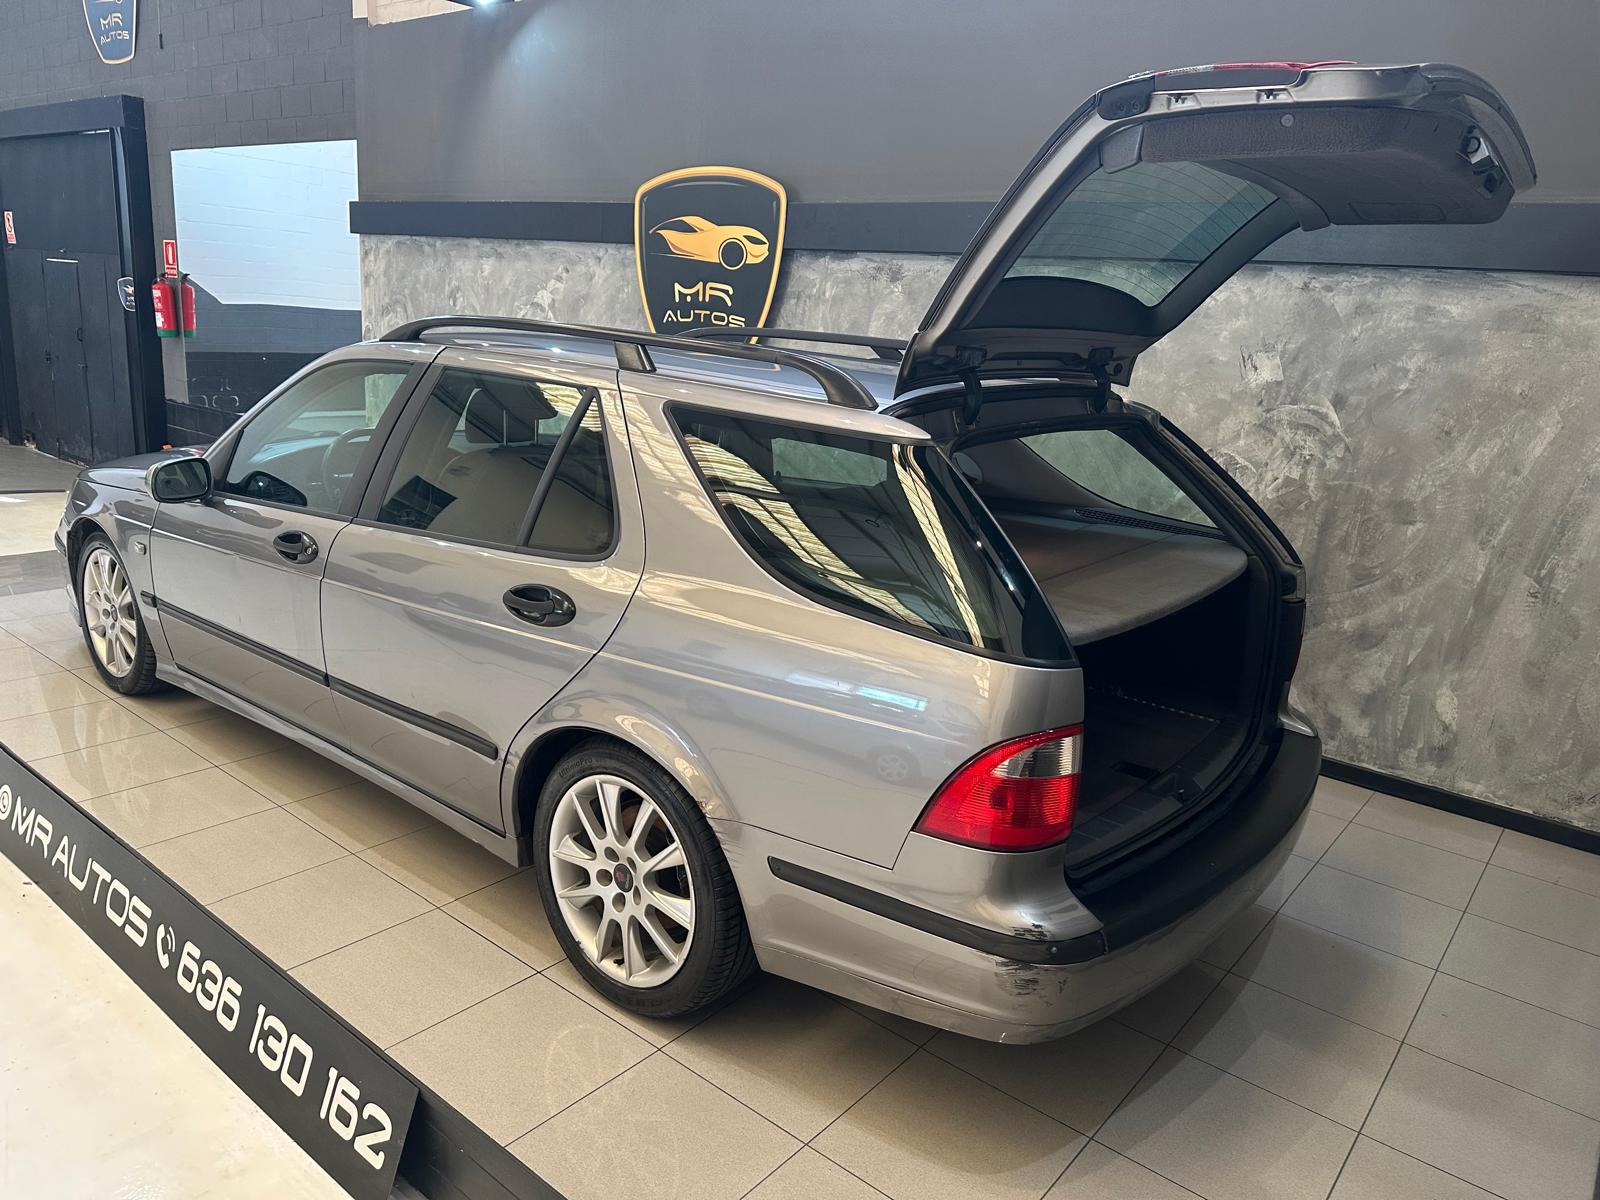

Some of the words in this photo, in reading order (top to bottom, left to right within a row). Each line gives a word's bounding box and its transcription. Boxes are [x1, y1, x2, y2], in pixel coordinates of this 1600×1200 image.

[100, 12, 123, 31] MR
[100, 30, 130, 45] AUTOS
[674, 281, 734, 307] MR
[663, 309, 746, 328] AUTOS
[11, 795, 53, 859] MR
[51, 835, 153, 947] AUTOS
[176, 940, 243, 1032] 636
[248, 1003, 314, 1097] 130
[319, 1066, 393, 1170] 162
